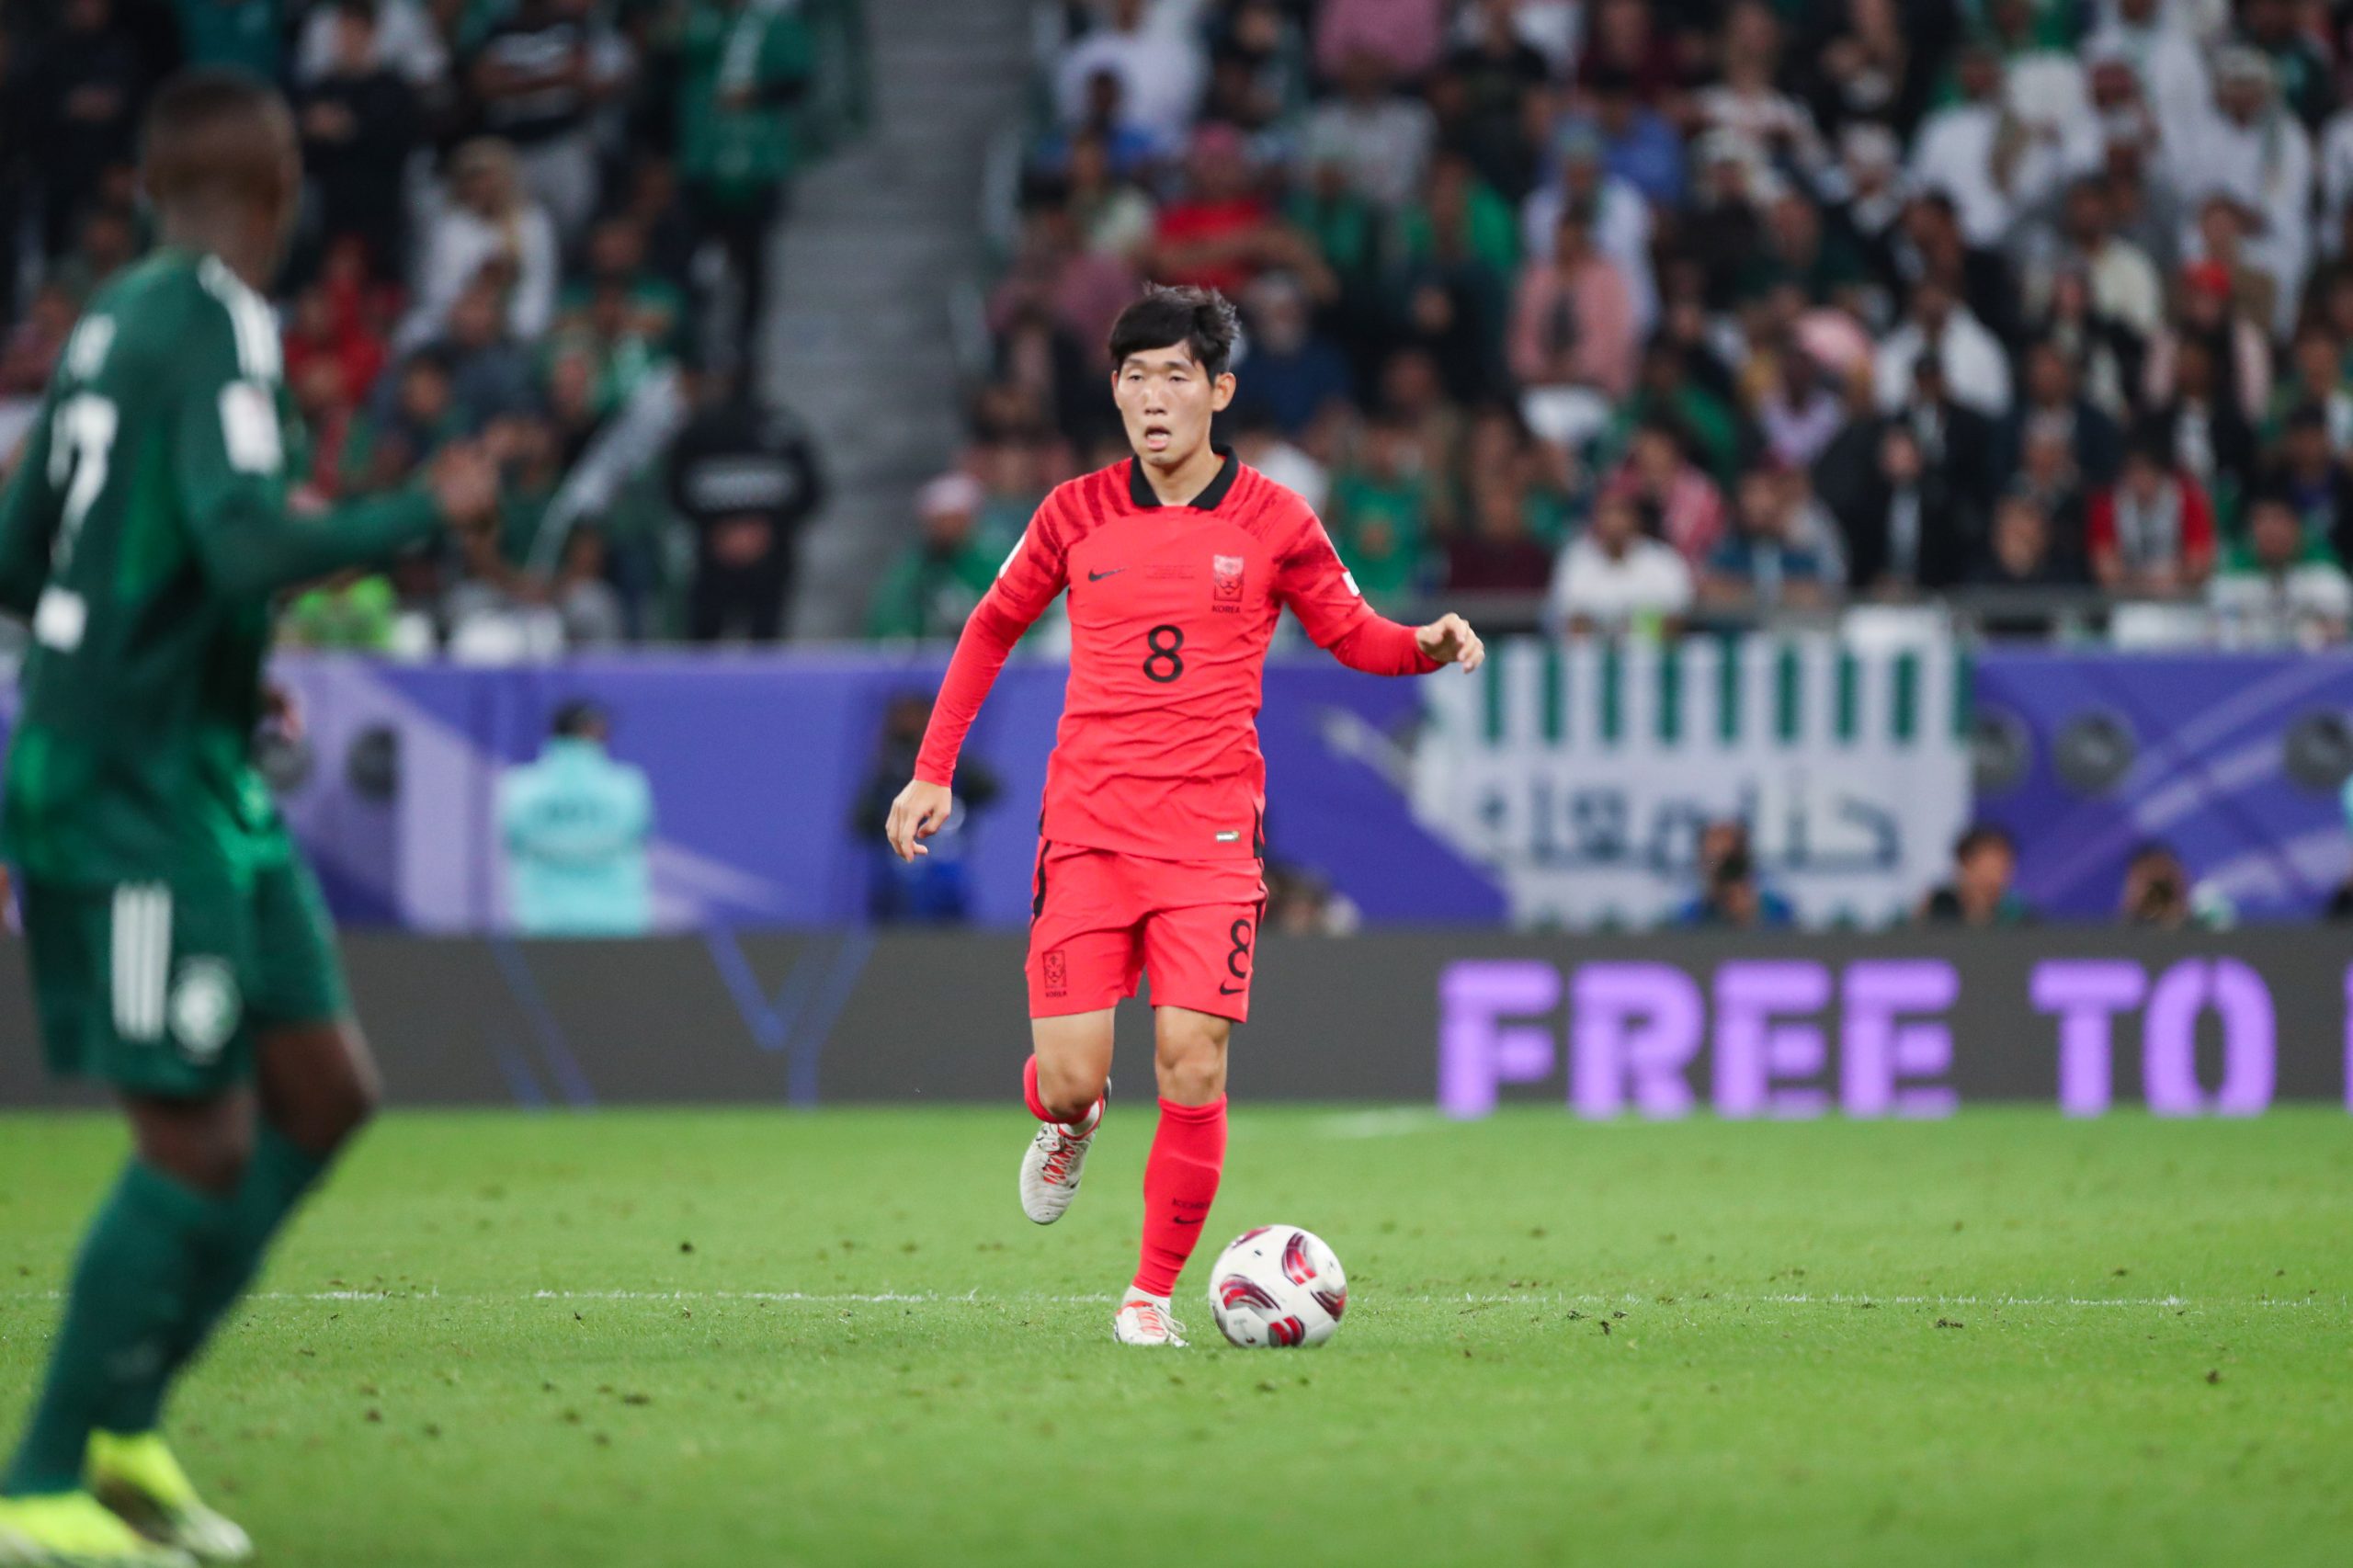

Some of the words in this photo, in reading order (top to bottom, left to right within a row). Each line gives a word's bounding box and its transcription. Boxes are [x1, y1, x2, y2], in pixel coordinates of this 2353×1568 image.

[1211, 604, 1241, 614] KOREA
[1142, 624, 1184, 683] 8
[1227, 918, 1252, 980] 8
[1438, 960, 1960, 1119] FREE
[2029, 958, 2276, 1119] TO
